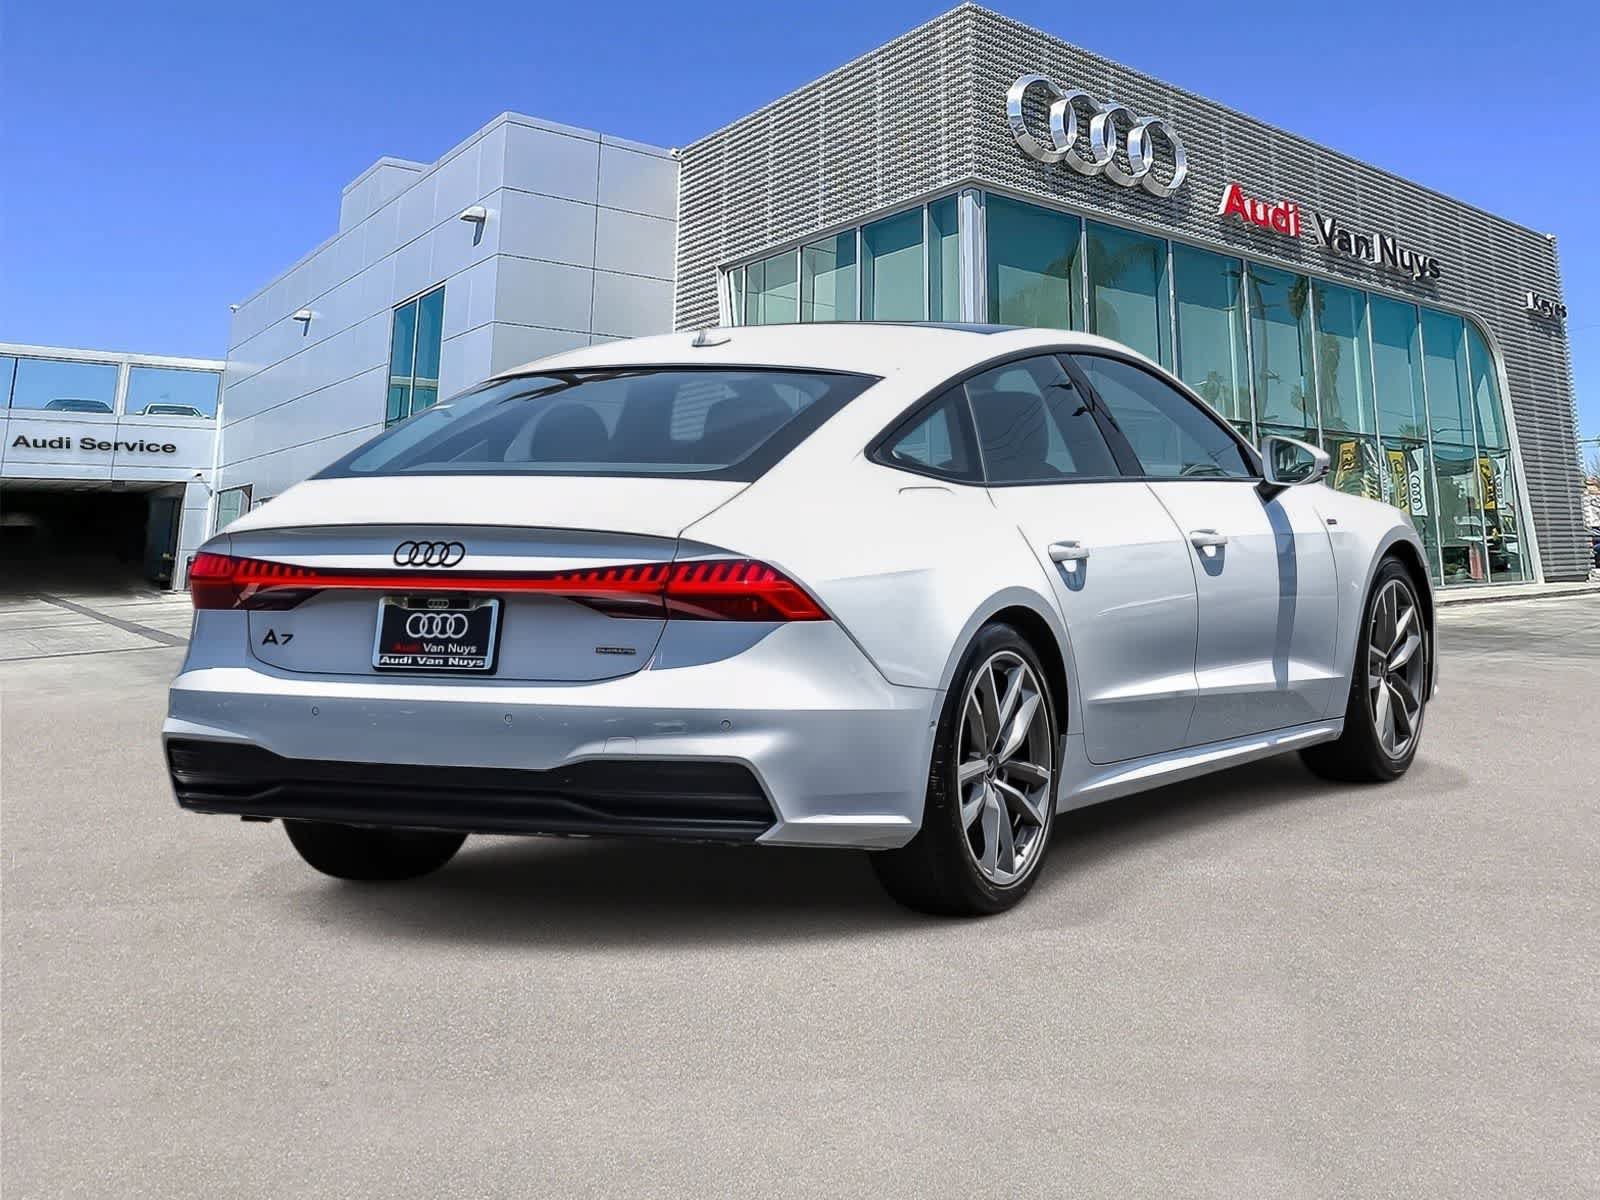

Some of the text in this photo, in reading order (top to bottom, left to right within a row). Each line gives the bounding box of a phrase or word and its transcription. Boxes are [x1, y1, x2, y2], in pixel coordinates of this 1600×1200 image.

[1217, 182, 1441, 280] Audi Van Nuys
[12, 434, 177, 453] Audi Service
[262, 628, 294, 646] A7
[423, 642, 445, 652] Van
[447, 643, 477, 655] Nuys
[380, 656, 484, 667] Audi Van Nuys
